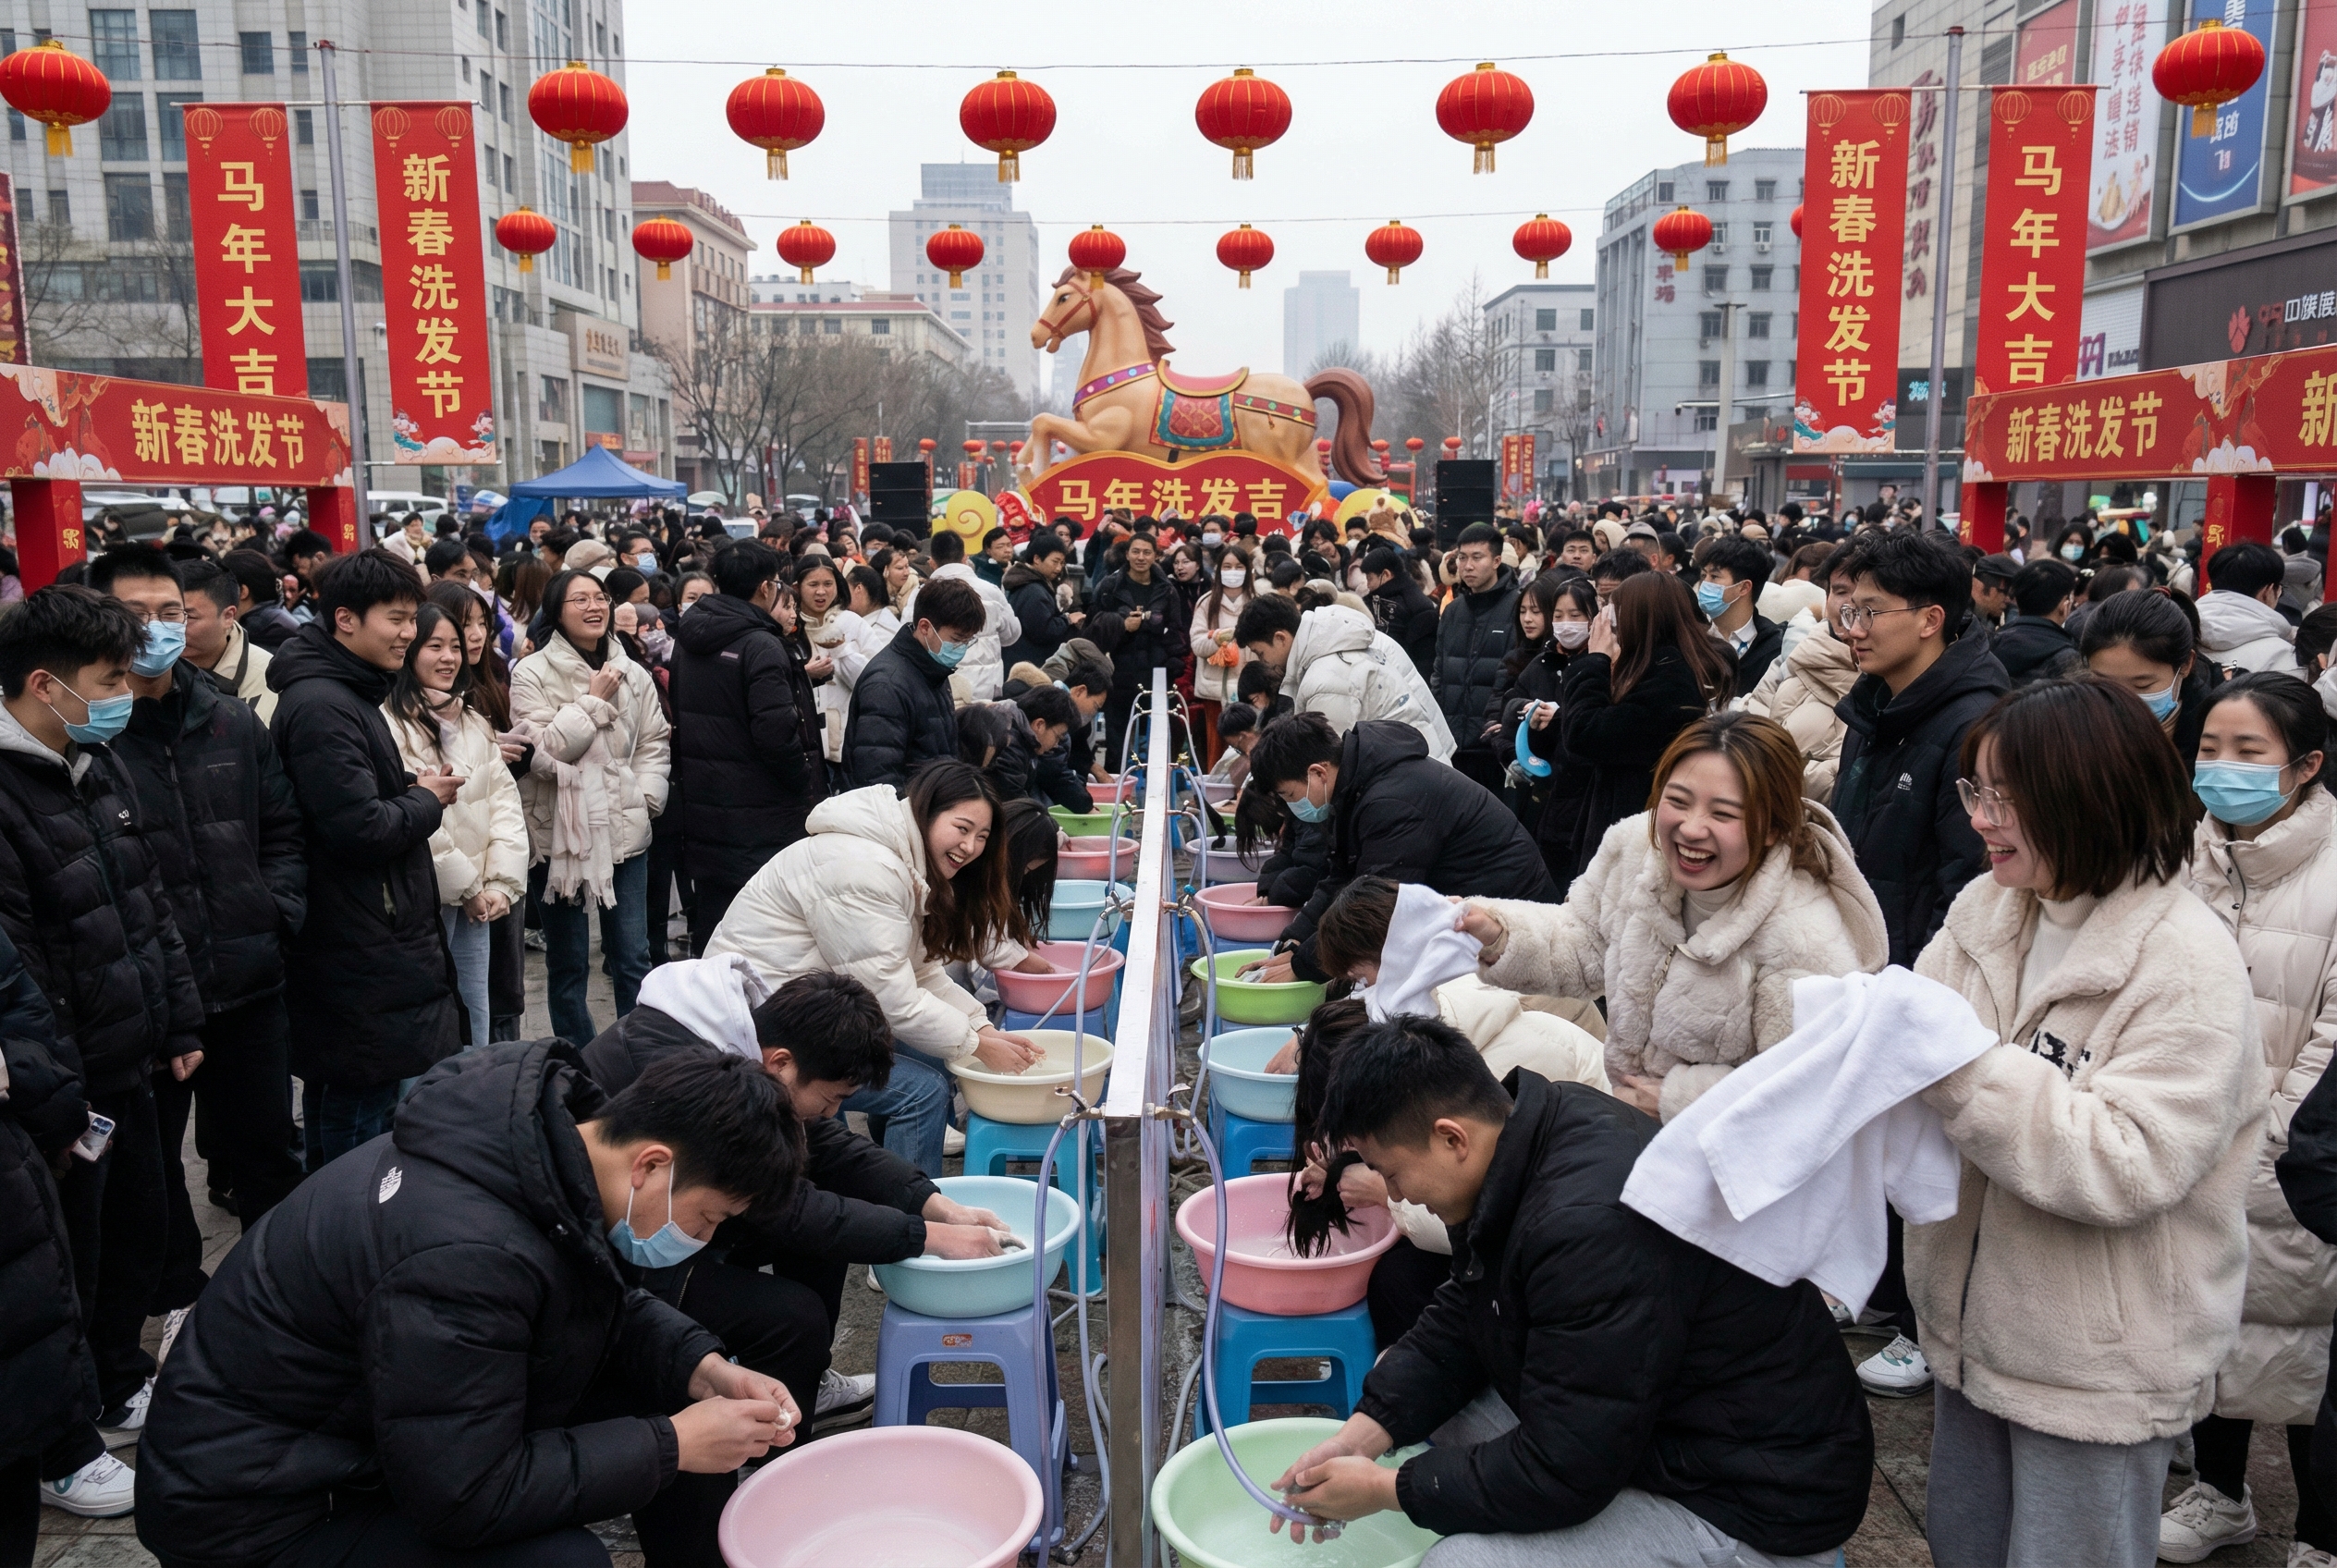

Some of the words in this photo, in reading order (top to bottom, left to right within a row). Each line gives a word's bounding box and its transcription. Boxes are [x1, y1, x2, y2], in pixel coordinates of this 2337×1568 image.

[218, 162, 277, 396] 马年大吉
[403, 153, 465, 419] 新春洗发节
[1824, 140, 1880, 407] 新春洗发节
[2005, 145, 2062, 384] 马年大吉
[131, 398, 304, 469] 新春洗发节
[1055, 477, 1287, 521] 马年洗发吉
[2005, 390, 2162, 463] 新春洗发节
